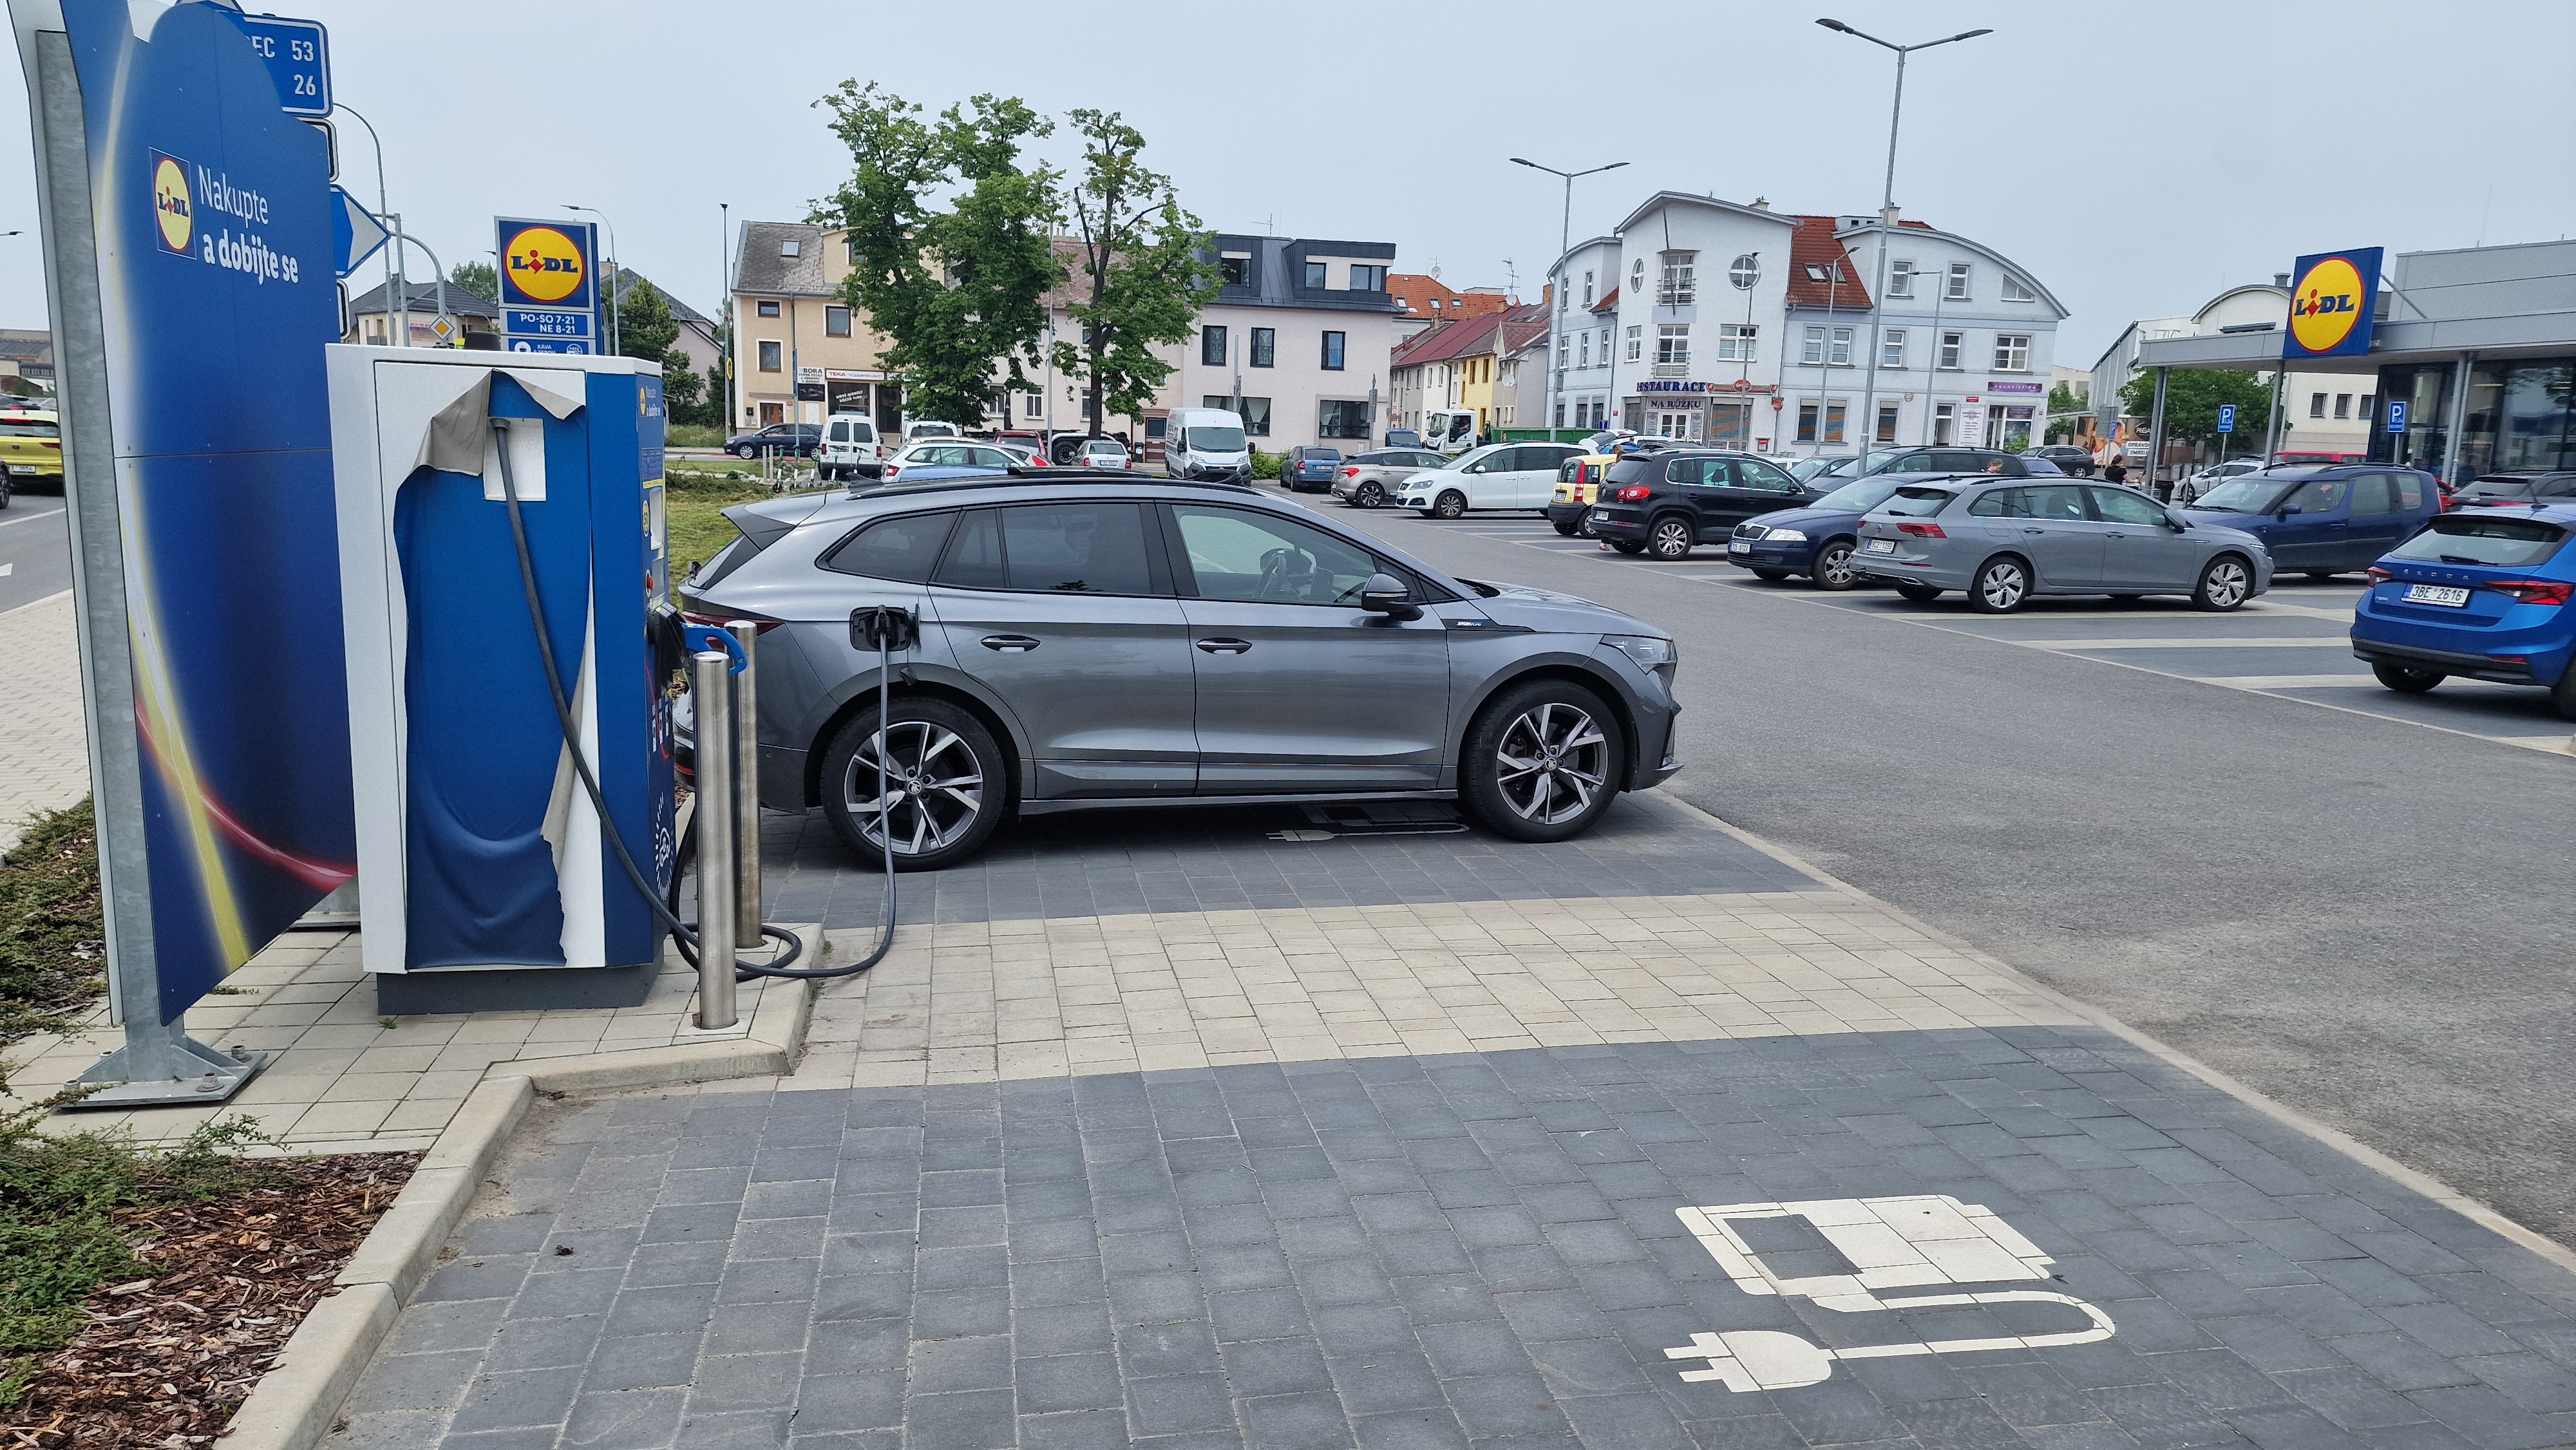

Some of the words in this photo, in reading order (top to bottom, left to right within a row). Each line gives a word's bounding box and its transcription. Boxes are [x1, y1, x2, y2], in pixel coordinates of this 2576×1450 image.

[245, 35, 276, 59] EC
[290, 39, 314, 62] 53
[293, 73, 316, 96] 26
[157, 185, 189, 218] LIDL
[198, 164, 269, 229] Nakupte
[203, 233, 216, 265] a
[218, 228, 279, 285] dobijte
[281, 254, 299, 283] se
[511, 249, 578, 274] LIDL
[2294, 288, 2355, 319] LIDL
[520, 313, 554, 323] PO-SO
[555, 315, 575, 325] 7-21
[540, 324, 554, 333] NE
[555, 325, 576, 334] 8-21
[2222, 408, 2231, 424] P
[2392, 405, 2402, 422] P
[2412, 586, 2432, 598] 3BE
[2436, 588, 2464, 601] 2616
